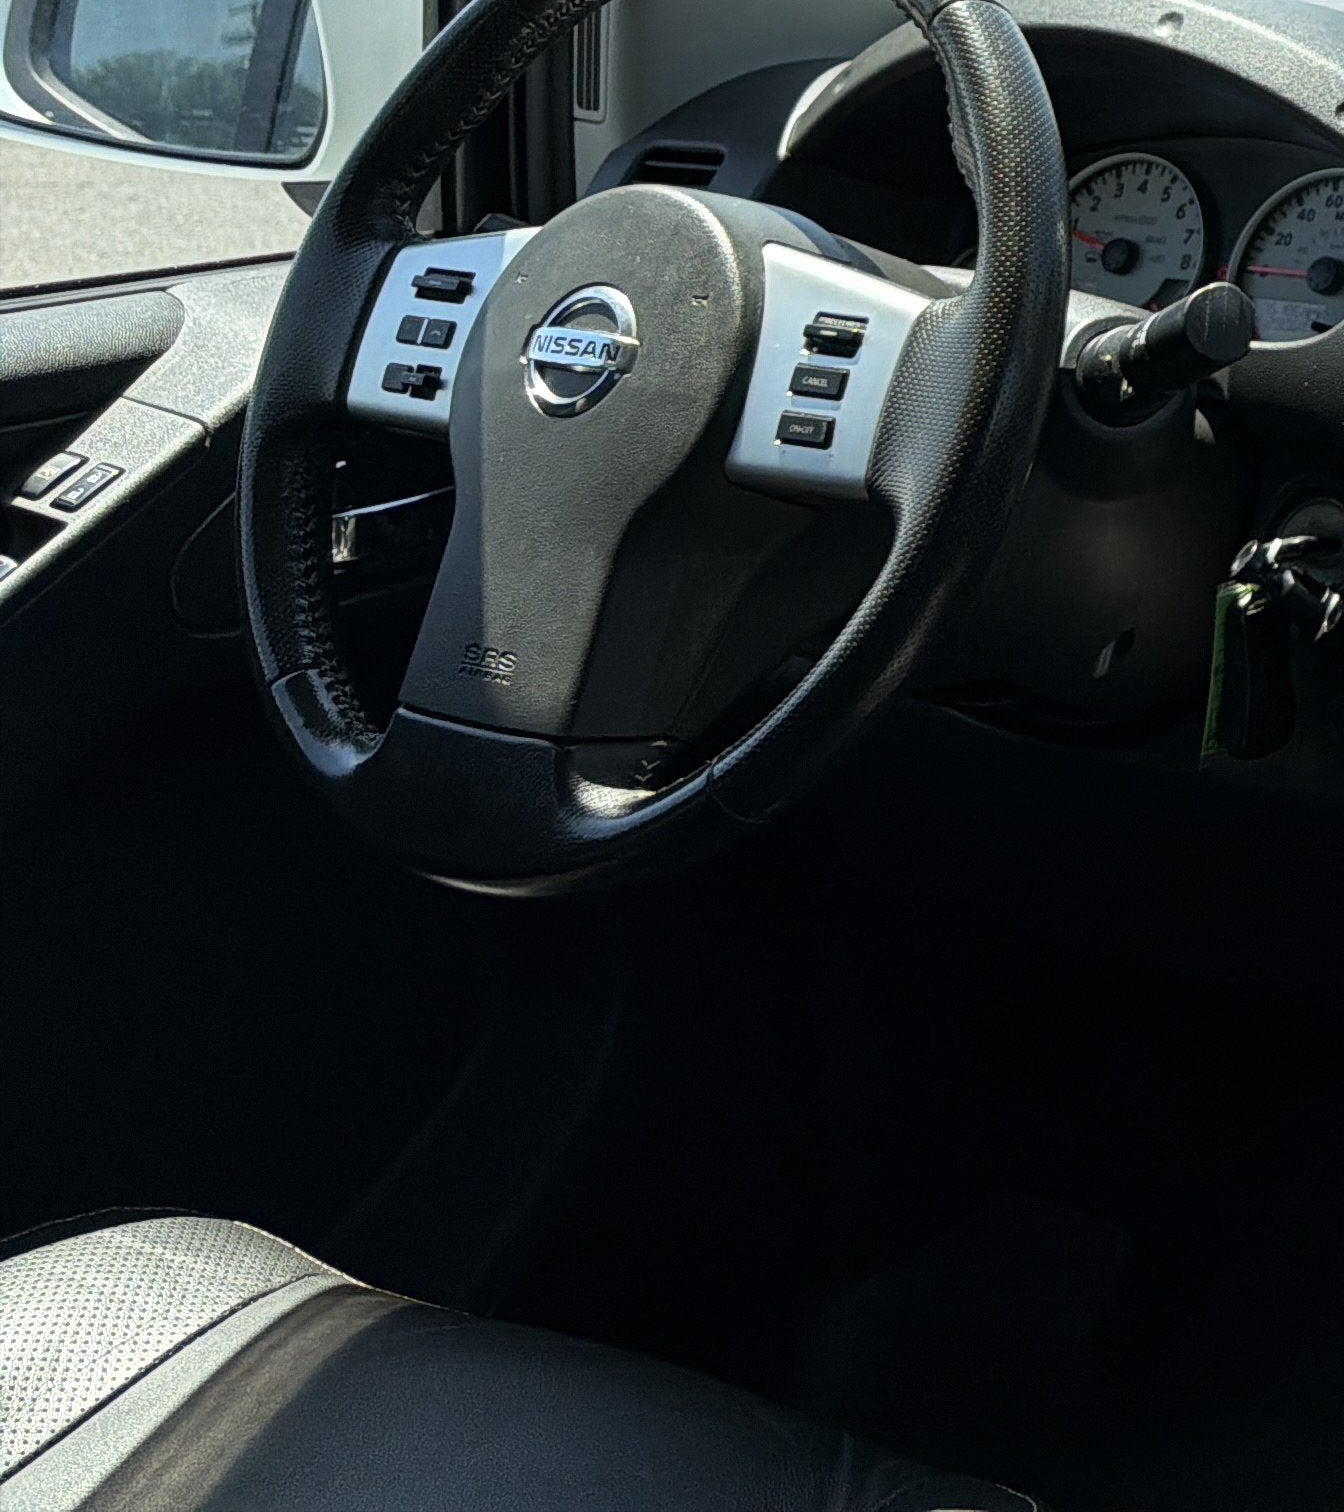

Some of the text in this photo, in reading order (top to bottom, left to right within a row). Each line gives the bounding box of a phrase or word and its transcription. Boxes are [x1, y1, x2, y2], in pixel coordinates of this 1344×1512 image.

[1114, 182, 1124, 198] 3
[1138, 179, 1148, 194] 4
[1161, 186, 1172, 202] 5
[1090, 195, 1101, 212] 2
[1325, 195, 1344, 208] 60
[1176, 204, 1187, 220] 6
[1297, 208, 1316, 222] 40
[1184, 228, 1195, 244] 7
[1275, 232, 1293, 247] 20
[1181, 254, 1192, 269] 8
[532, 334, 620, 362] NISSAN
[802, 375, 829, 388] CANCEL
[463, 643, 518, 672] SRS
